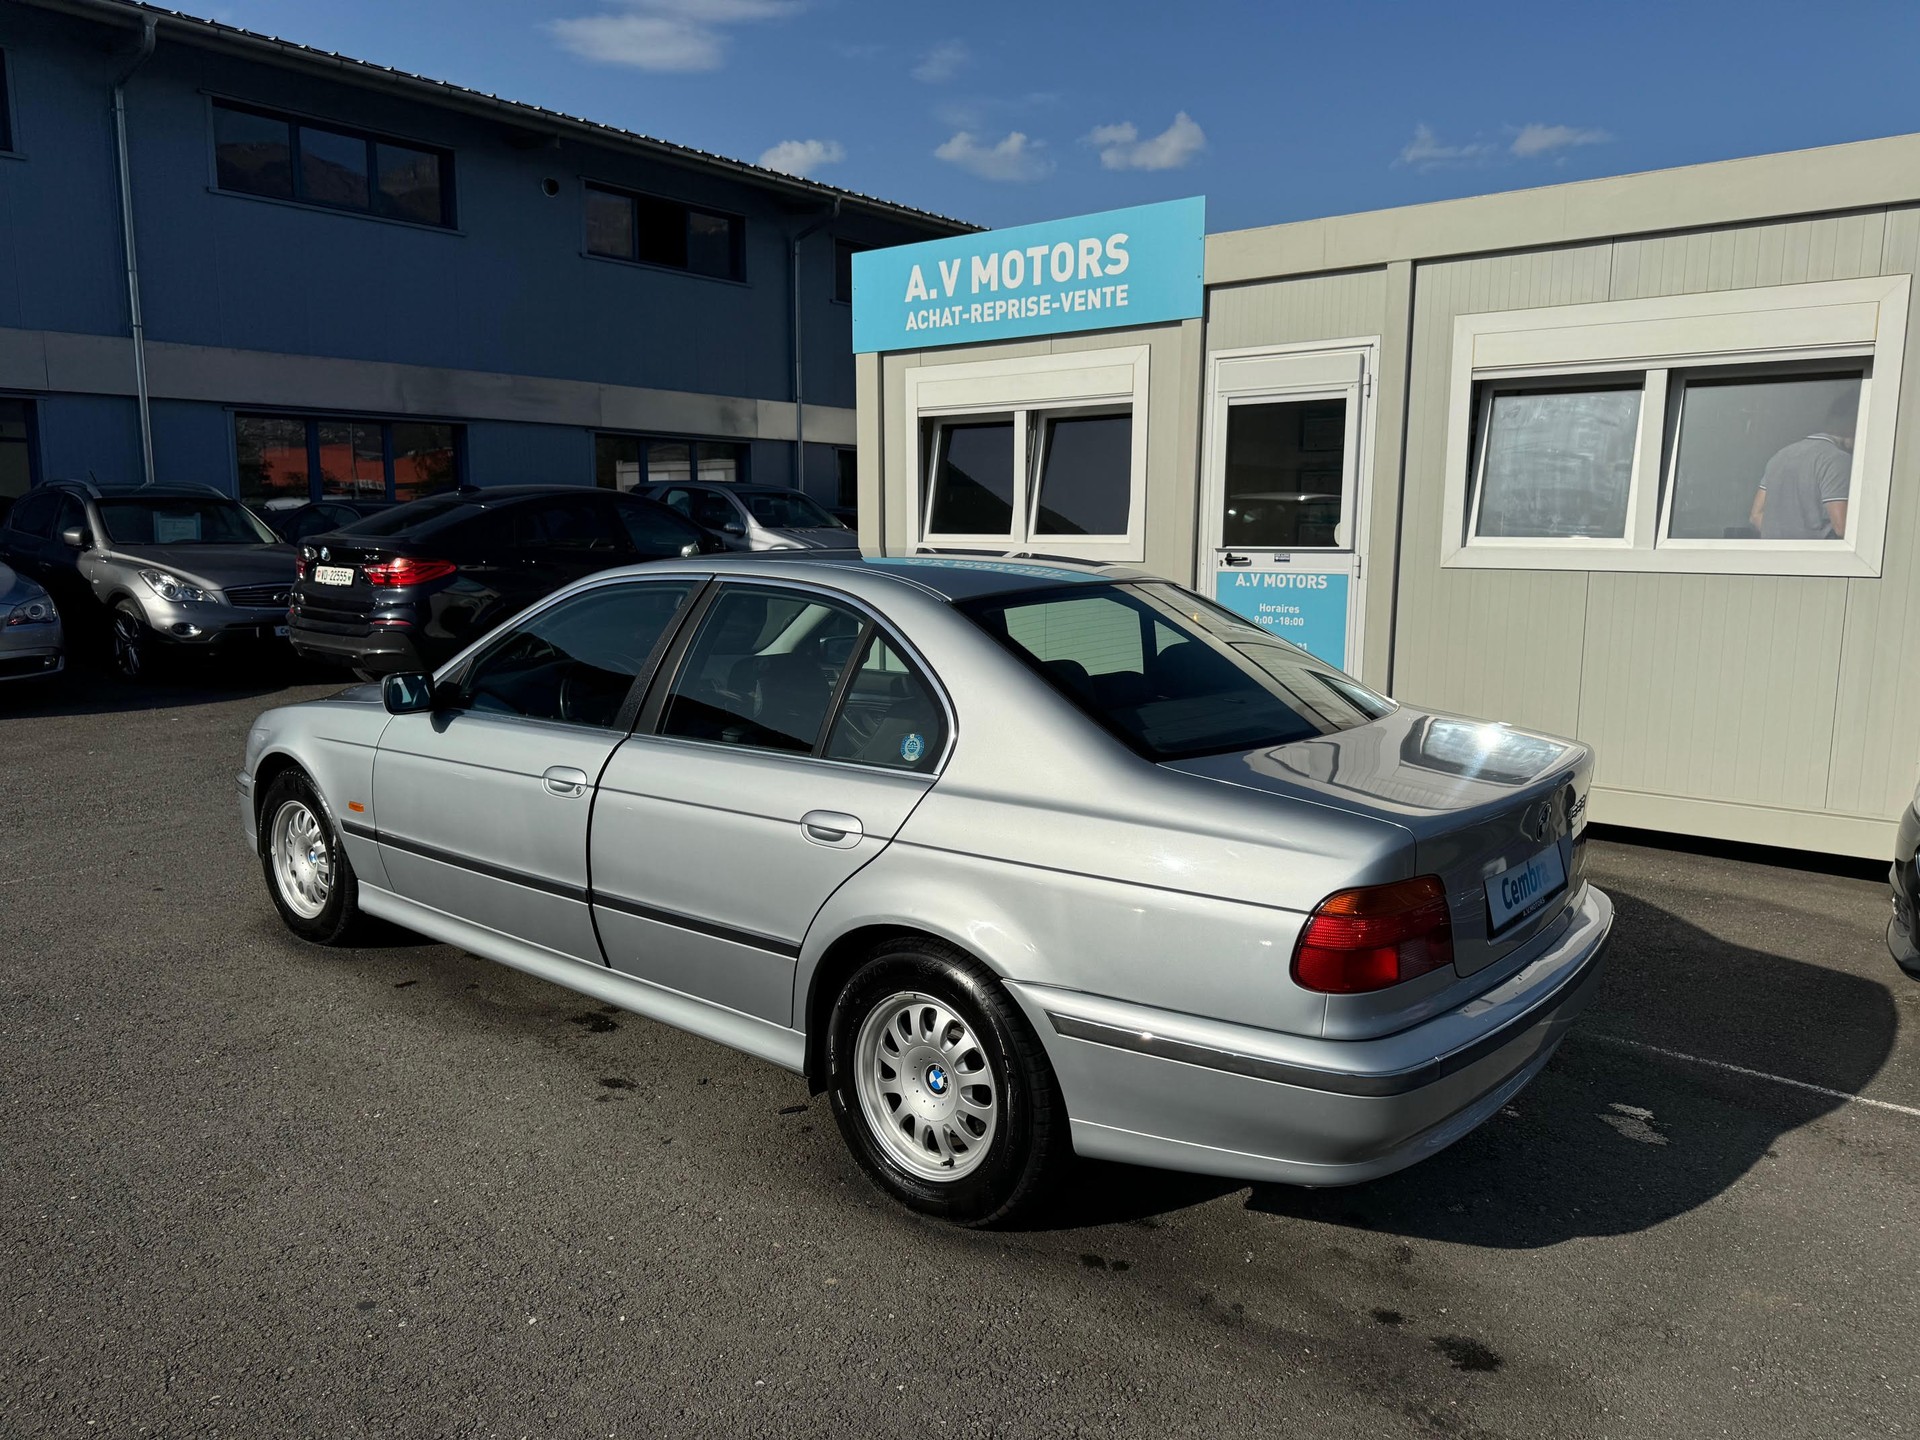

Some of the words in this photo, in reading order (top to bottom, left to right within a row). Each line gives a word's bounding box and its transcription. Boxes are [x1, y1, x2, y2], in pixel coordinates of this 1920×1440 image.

[905, 258, 961, 303] A.V
[971, 233, 1130, 294] MOTORS
[905, 284, 1129, 331] ACHAT-REPRISE-VENTE
[1235, 573, 1261, 587] A.V
[1264, 574, 1328, 589] MOTORS
[1259, 603, 1300, 614] Horaires
[1254, 616, 1273, 625] 9:00
